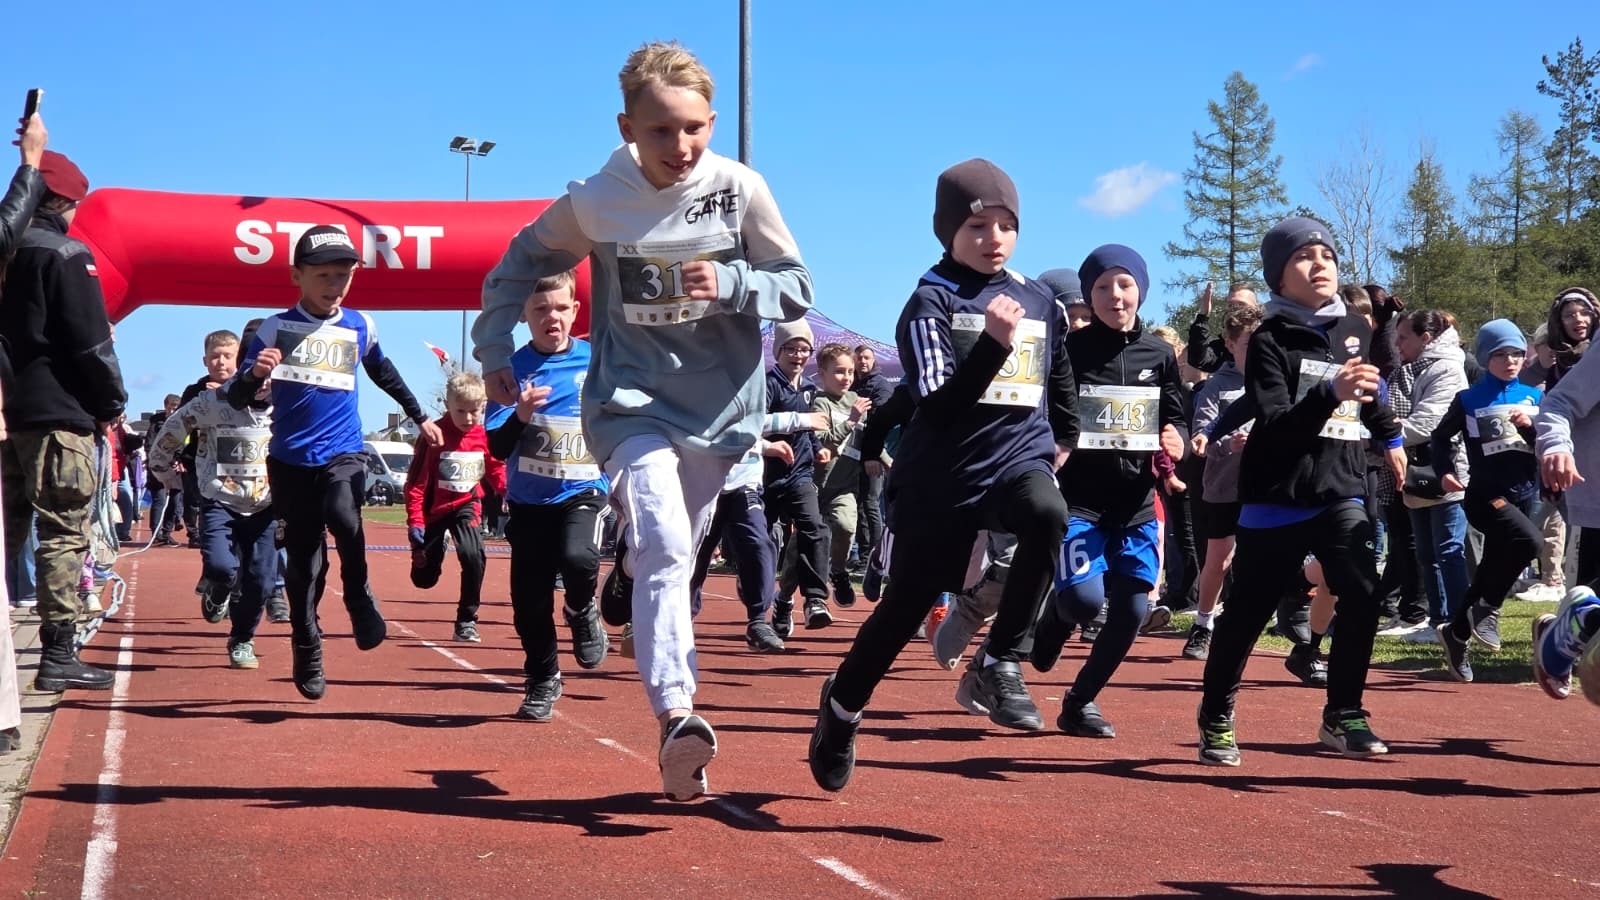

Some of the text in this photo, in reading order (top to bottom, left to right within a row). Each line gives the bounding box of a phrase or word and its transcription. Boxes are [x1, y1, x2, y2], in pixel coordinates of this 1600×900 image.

[685, 194, 739, 224] GAME
[233, 219, 444, 270] STRT
[640, 261, 689, 300] 31
[291, 337, 343, 369] 490
[1095, 401, 1147, 431] 443
[535, 430, 587, 462] 240
[1058, 538, 1090, 581] 16
